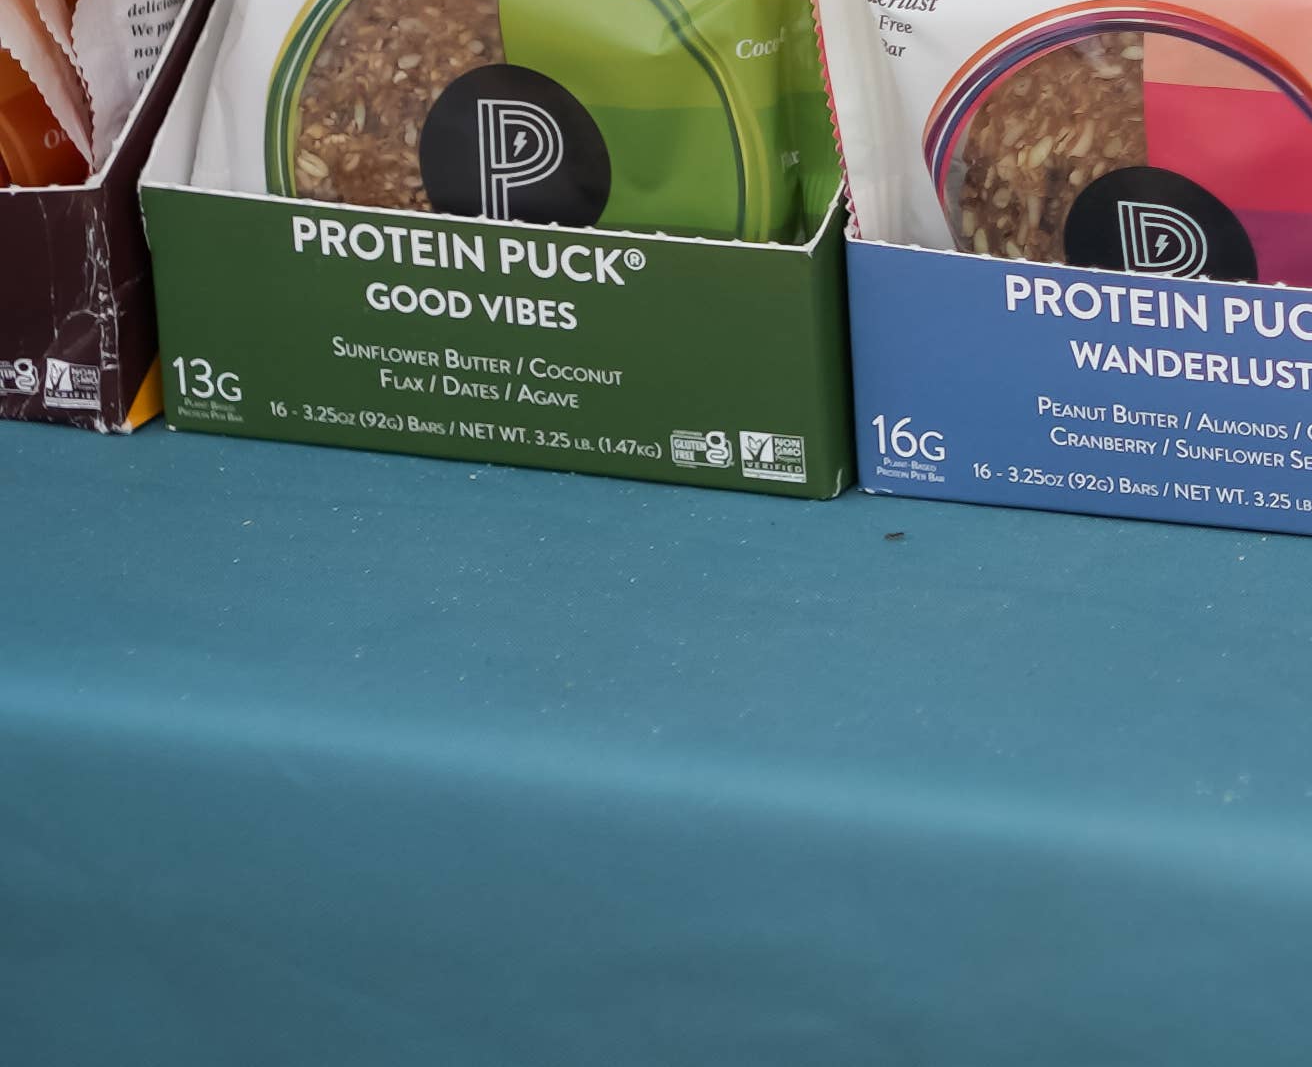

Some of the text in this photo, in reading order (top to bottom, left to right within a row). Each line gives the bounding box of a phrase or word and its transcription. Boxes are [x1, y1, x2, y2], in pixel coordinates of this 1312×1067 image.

[879, 14, 913, 35] Free
[292, 215, 486, 272] PROTEIN
[365, 282, 578, 331] GOOD VIBES
[1005, 274, 1209, 333] PROTEIN
[973, 463, 992, 480] 16
[1174, 483, 1211, 502] NET
[1216, 489, 1249, 506] WT.
[1253, 491, 1292, 510] 3.25
